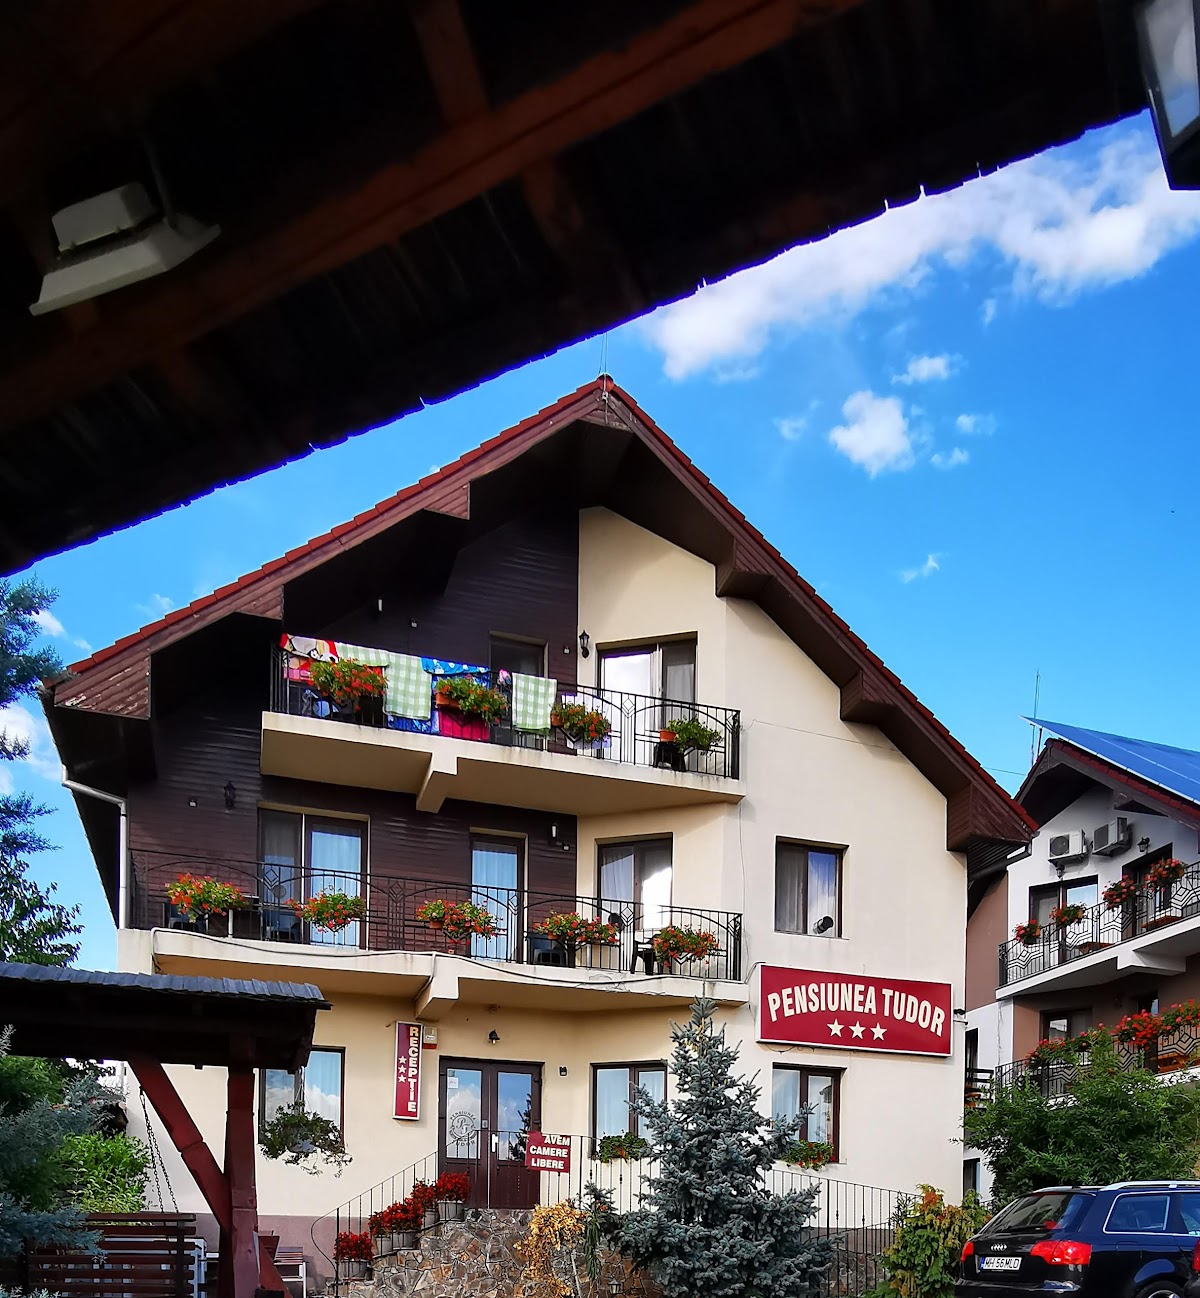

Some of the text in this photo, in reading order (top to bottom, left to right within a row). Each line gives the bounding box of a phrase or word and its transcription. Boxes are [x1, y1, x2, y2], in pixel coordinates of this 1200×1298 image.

[767, 982, 946, 1037] PENSIUNEA TUDOR
[544, 1135, 570, 1146] AVEM
[530, 1145, 568, 1158] CAMERE
[531, 1158, 565, 1170] LIBERE
